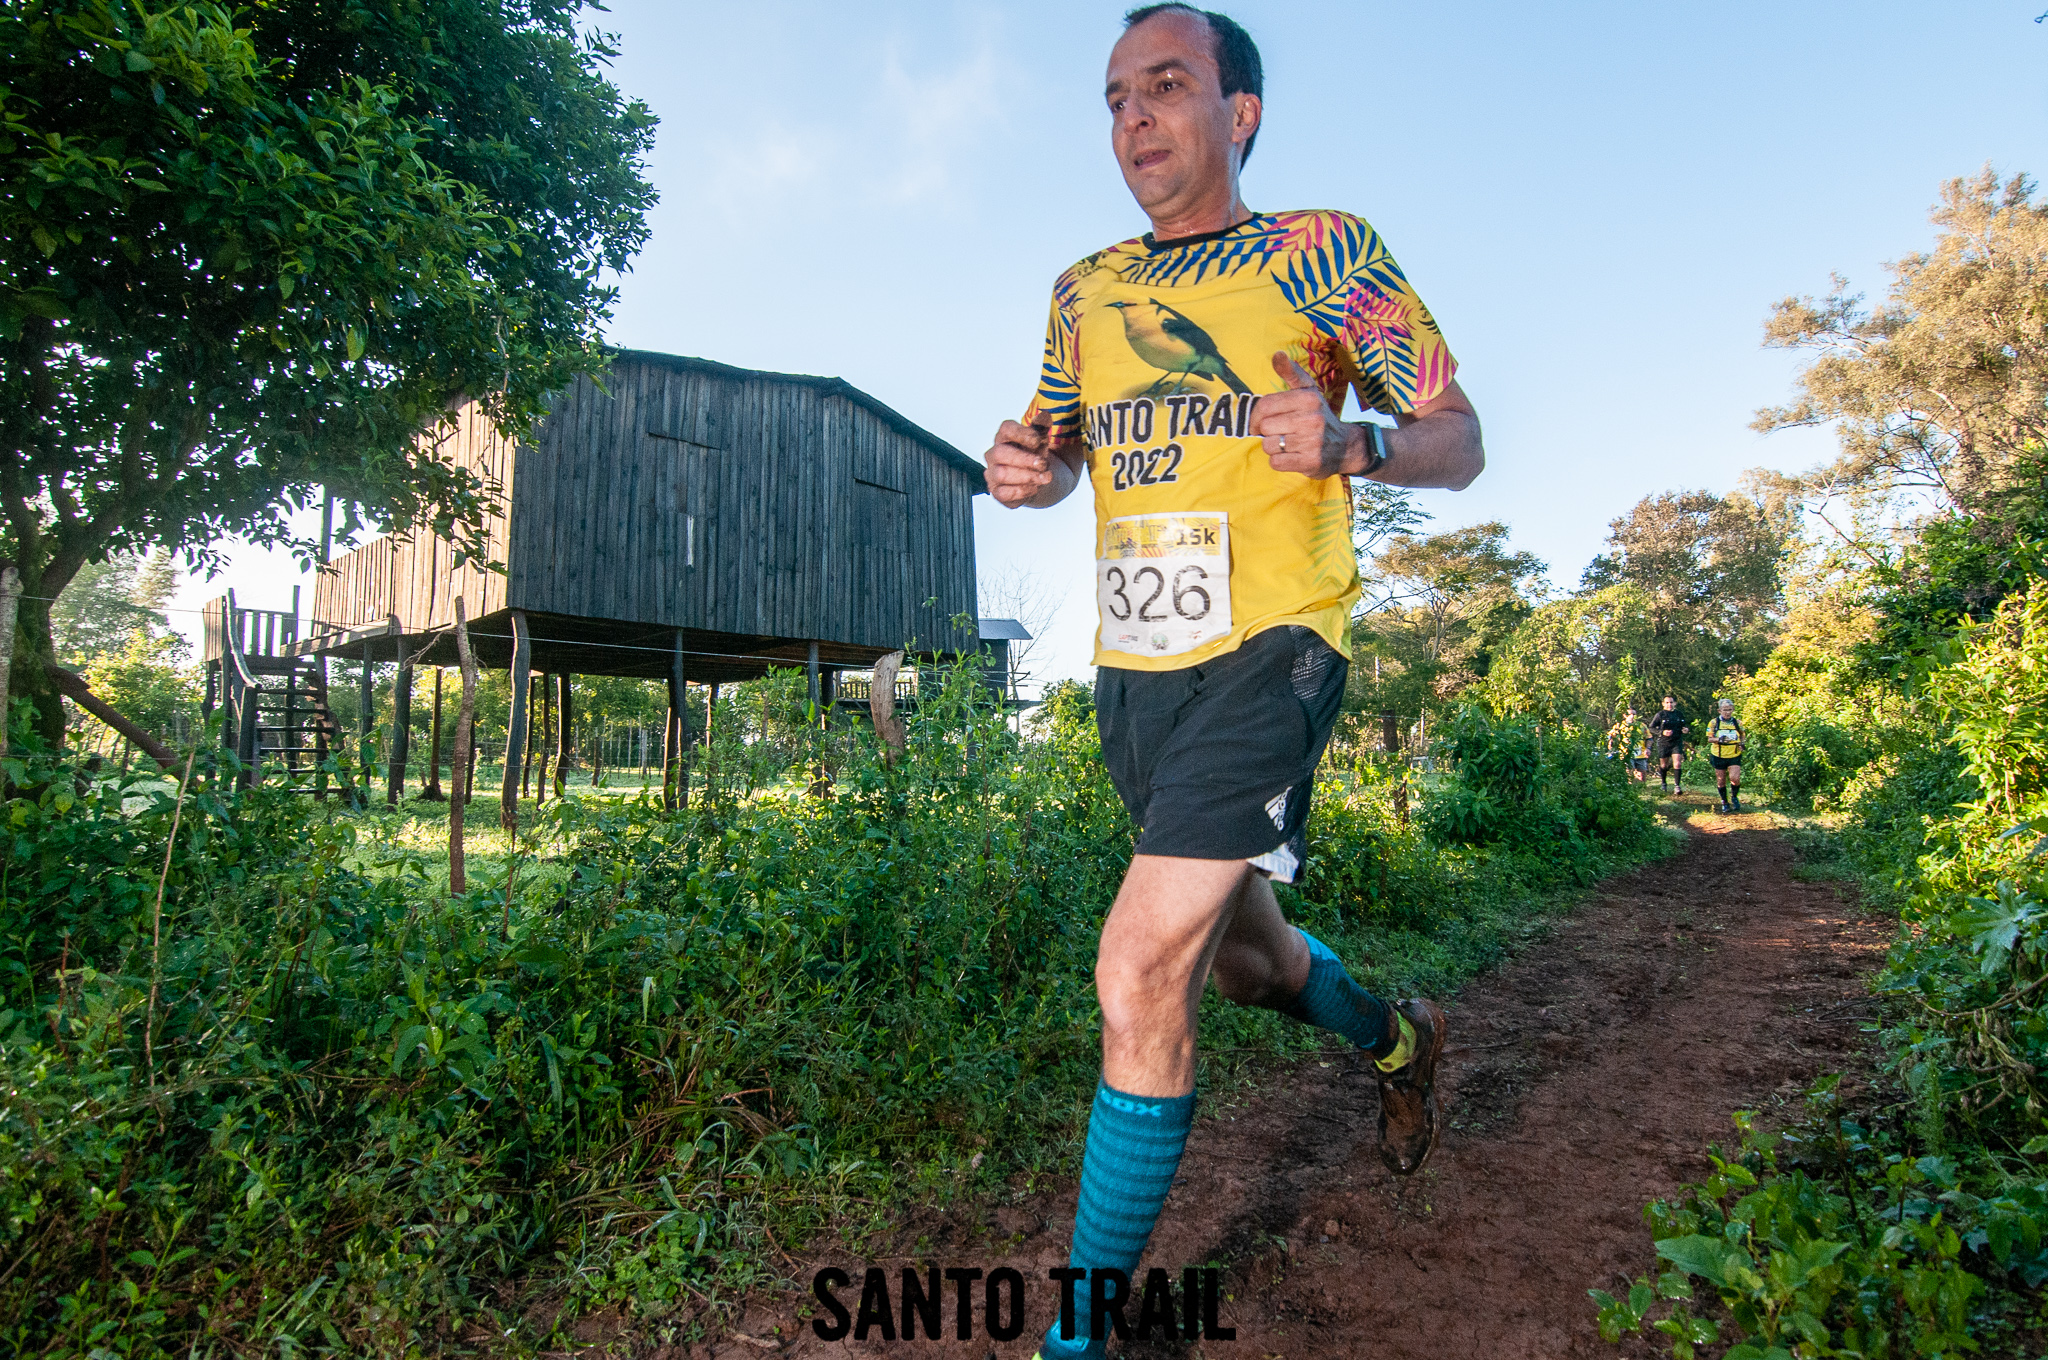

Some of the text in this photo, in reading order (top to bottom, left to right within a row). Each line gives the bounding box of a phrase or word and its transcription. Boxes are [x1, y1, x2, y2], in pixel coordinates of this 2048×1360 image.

[1083, 397, 1155, 452] ANTO
[1111, 441, 1184, 492] 2022
[1176, 527, 1216, 545] 15k
[1106, 565, 1211, 622] 326
